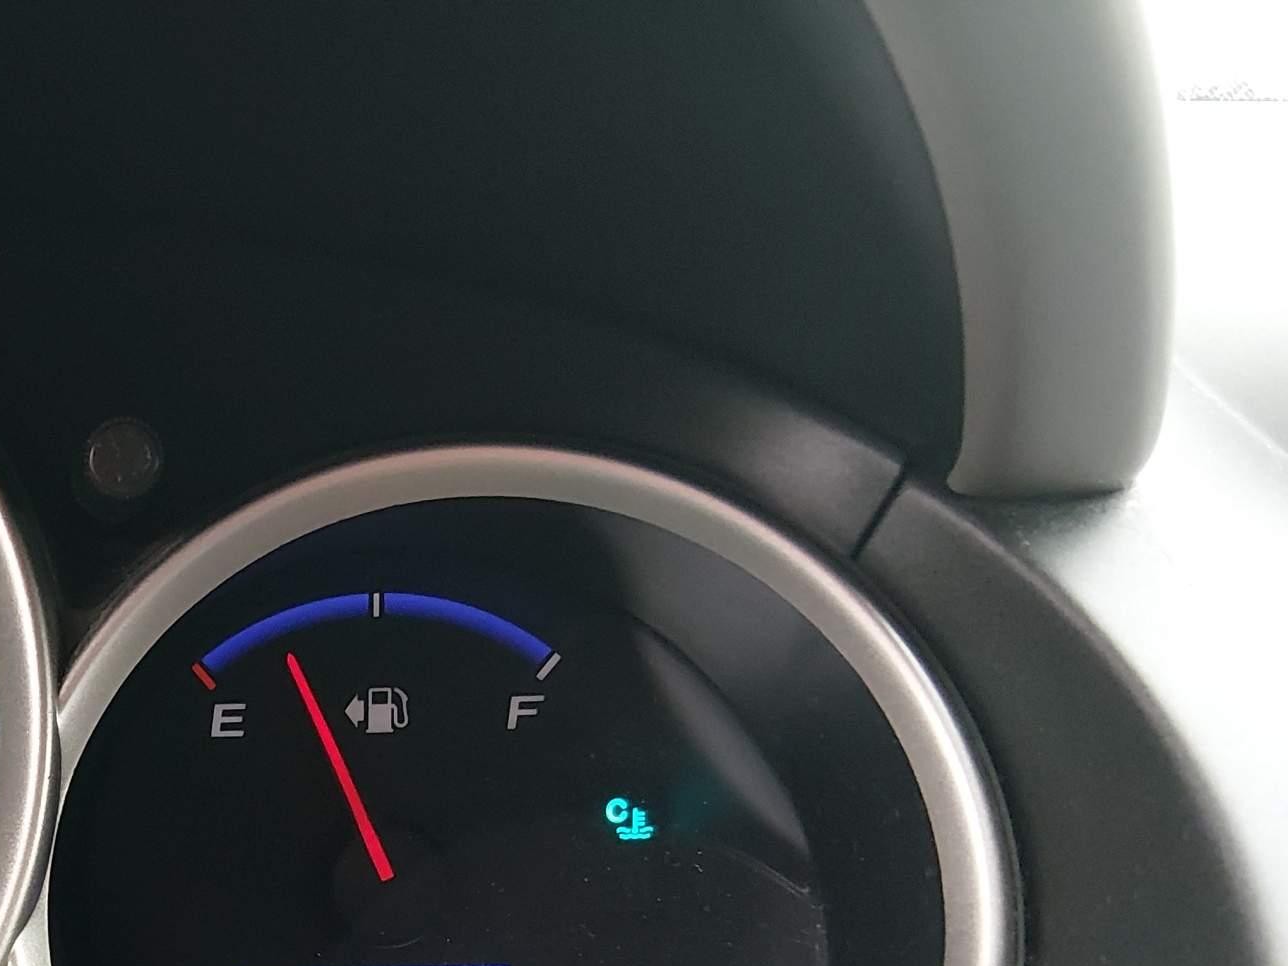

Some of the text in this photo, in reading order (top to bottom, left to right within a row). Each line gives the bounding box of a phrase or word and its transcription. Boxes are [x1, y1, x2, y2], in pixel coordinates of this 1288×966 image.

[211, 703, 246, 737] E
[507, 695, 544, 729] F
[605, 798, 628, 822] C
